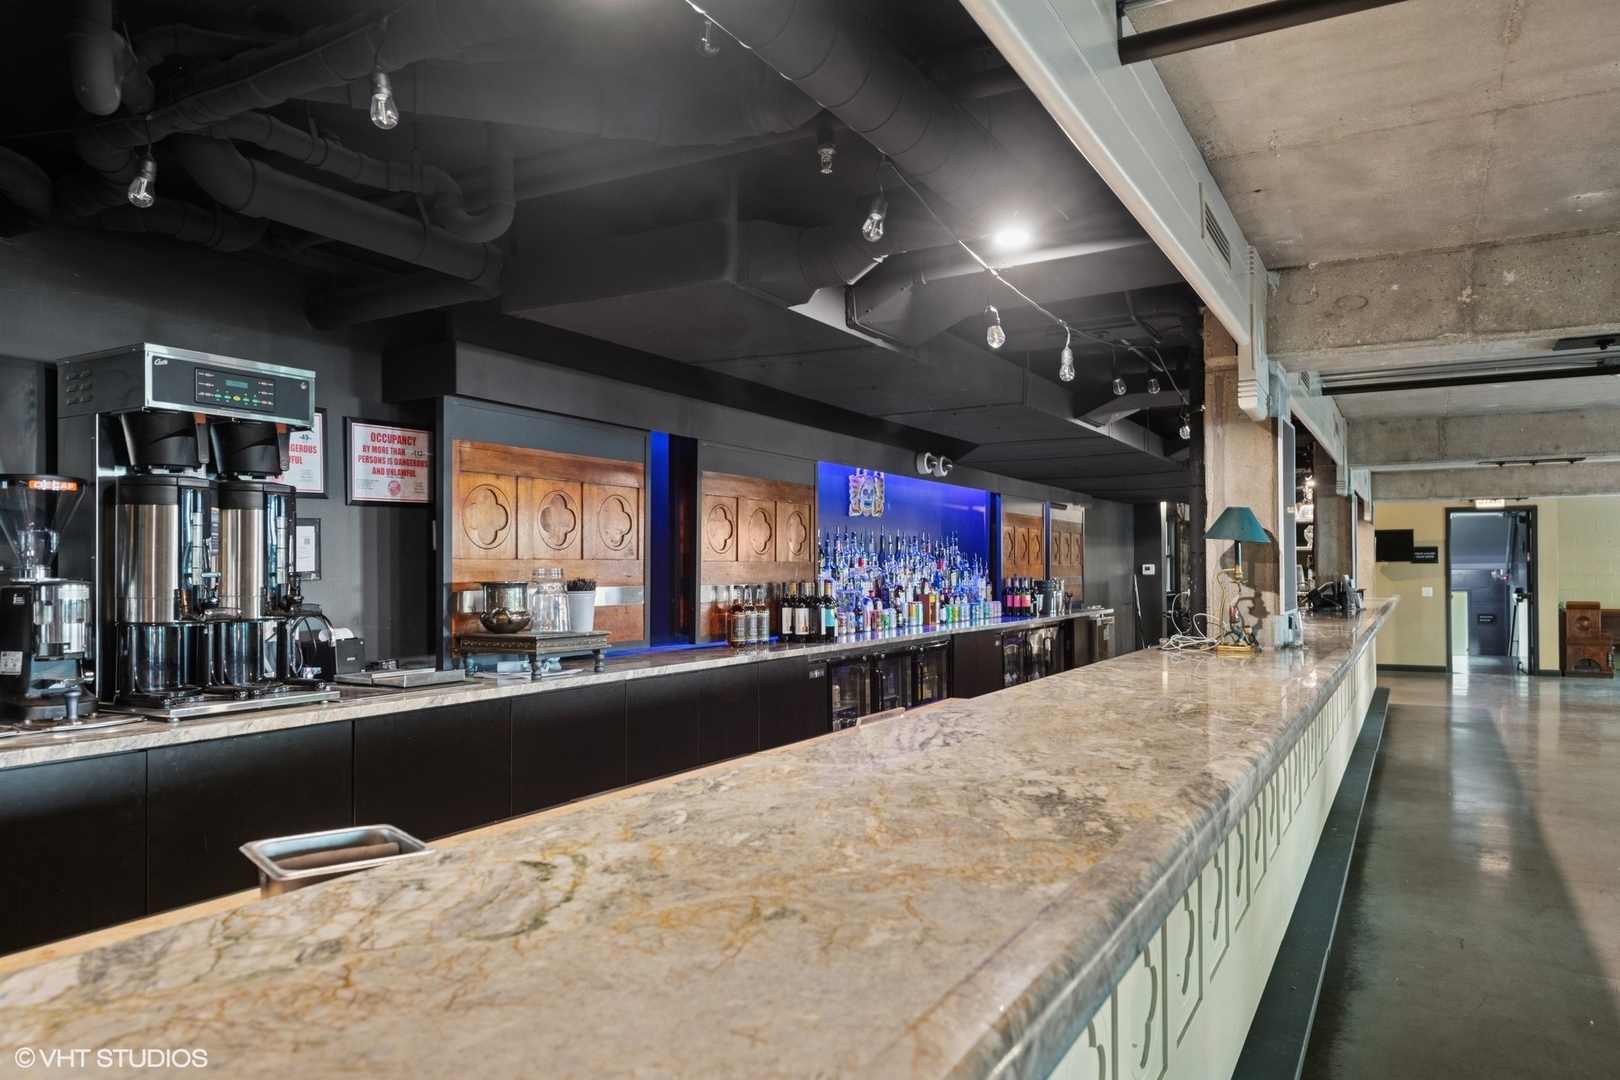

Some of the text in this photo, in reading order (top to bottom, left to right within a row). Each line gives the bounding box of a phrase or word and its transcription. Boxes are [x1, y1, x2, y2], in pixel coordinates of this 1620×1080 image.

[370, 432, 417, 446] OCCUPANCY
[362, 444, 370, 453] BY
[372, 445, 389, 454] MORE
[390, 447, 406, 456] THAN
[358, 455, 429, 468] PERSONS IS DANGEROUS
[372, 467, 385, 475] AND
[385, 468, 417, 478] UNLAWFUL
[34, 480, 74, 490] DECAF
